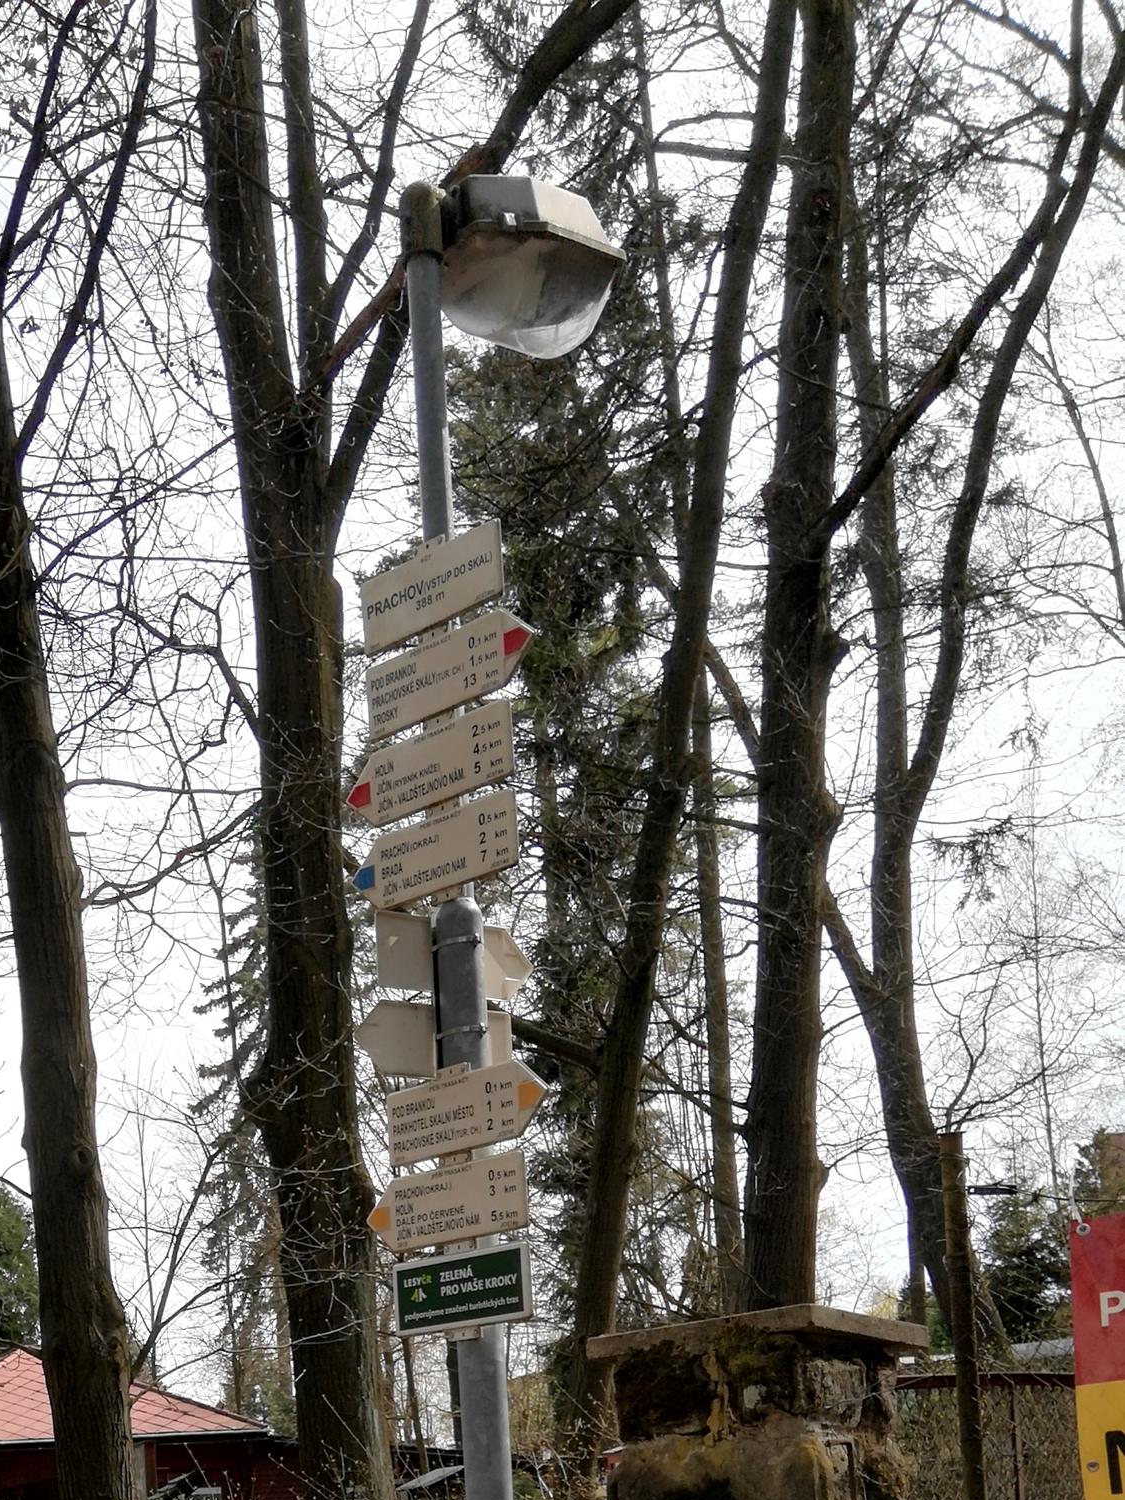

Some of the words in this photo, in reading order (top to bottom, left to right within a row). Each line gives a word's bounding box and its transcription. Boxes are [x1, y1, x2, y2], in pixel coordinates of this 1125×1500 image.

[367, 580, 424, 620] PRACHOV
[454, 564, 466, 578] DO
[468, 551, 493, 574] SKAL)
[415, 596, 433, 611] 388
[435, 591, 445, 601] m
[371, 676, 385, 692] POD
[385, 663, 417, 687] BRANKOU
[483, 631, 497, 642] km
[484, 650, 498, 661] km
[373, 706, 399, 727] TROSKY
[463, 673, 477, 689] 13
[485, 669, 499, 679] km
[488, 720, 501, 731] km
[473, 743, 487, 755] 4,5
[489, 739, 502, 750] km
[474, 761, 481, 774] 5
[490, 757, 503, 767] km
[380, 839, 410, 862] PRACHOV
[494, 810, 507, 820] km
[381, 863, 403, 880] BRADA
[479, 831, 486, 845] 2
[494, 828, 507, 839] km
[480, 850, 487, 863] 7
[496, 847, 509, 857] km
[392, 1105, 405, 1119] POD
[500, 1080, 513, 1089] km
[393, 1117, 429, 1137] PARKHOTEL
[452, 1104, 475, 1120] MĚSTO
[486, 1101, 492, 1112] 1
[501, 1099, 513, 1108] km
[487, 1118, 494, 1131] 2
[502, 1117, 514, 1126] km
[395, 1184, 424, 1201] PRACHOV
[503, 1168, 516, 1177] km
[489, 1185, 496, 1196] 3
[504, 1184, 517, 1193] km
[417, 1212, 428, 1222] PO
[505, 1209, 518, 1218] km
[439, 1264, 473, 1282] ZELENÁ
[440, 1284, 460, 1297] PRO
[460, 1278, 483, 1293] VAŠE
[485, 1273, 518, 1290] KROKY
[404, 1308, 444, 1323] podporujeme
[445, 1304, 469, 1316] značení
[469, 1298, 506, 1312] turistických
[506, 1296, 519, 1304] tras
